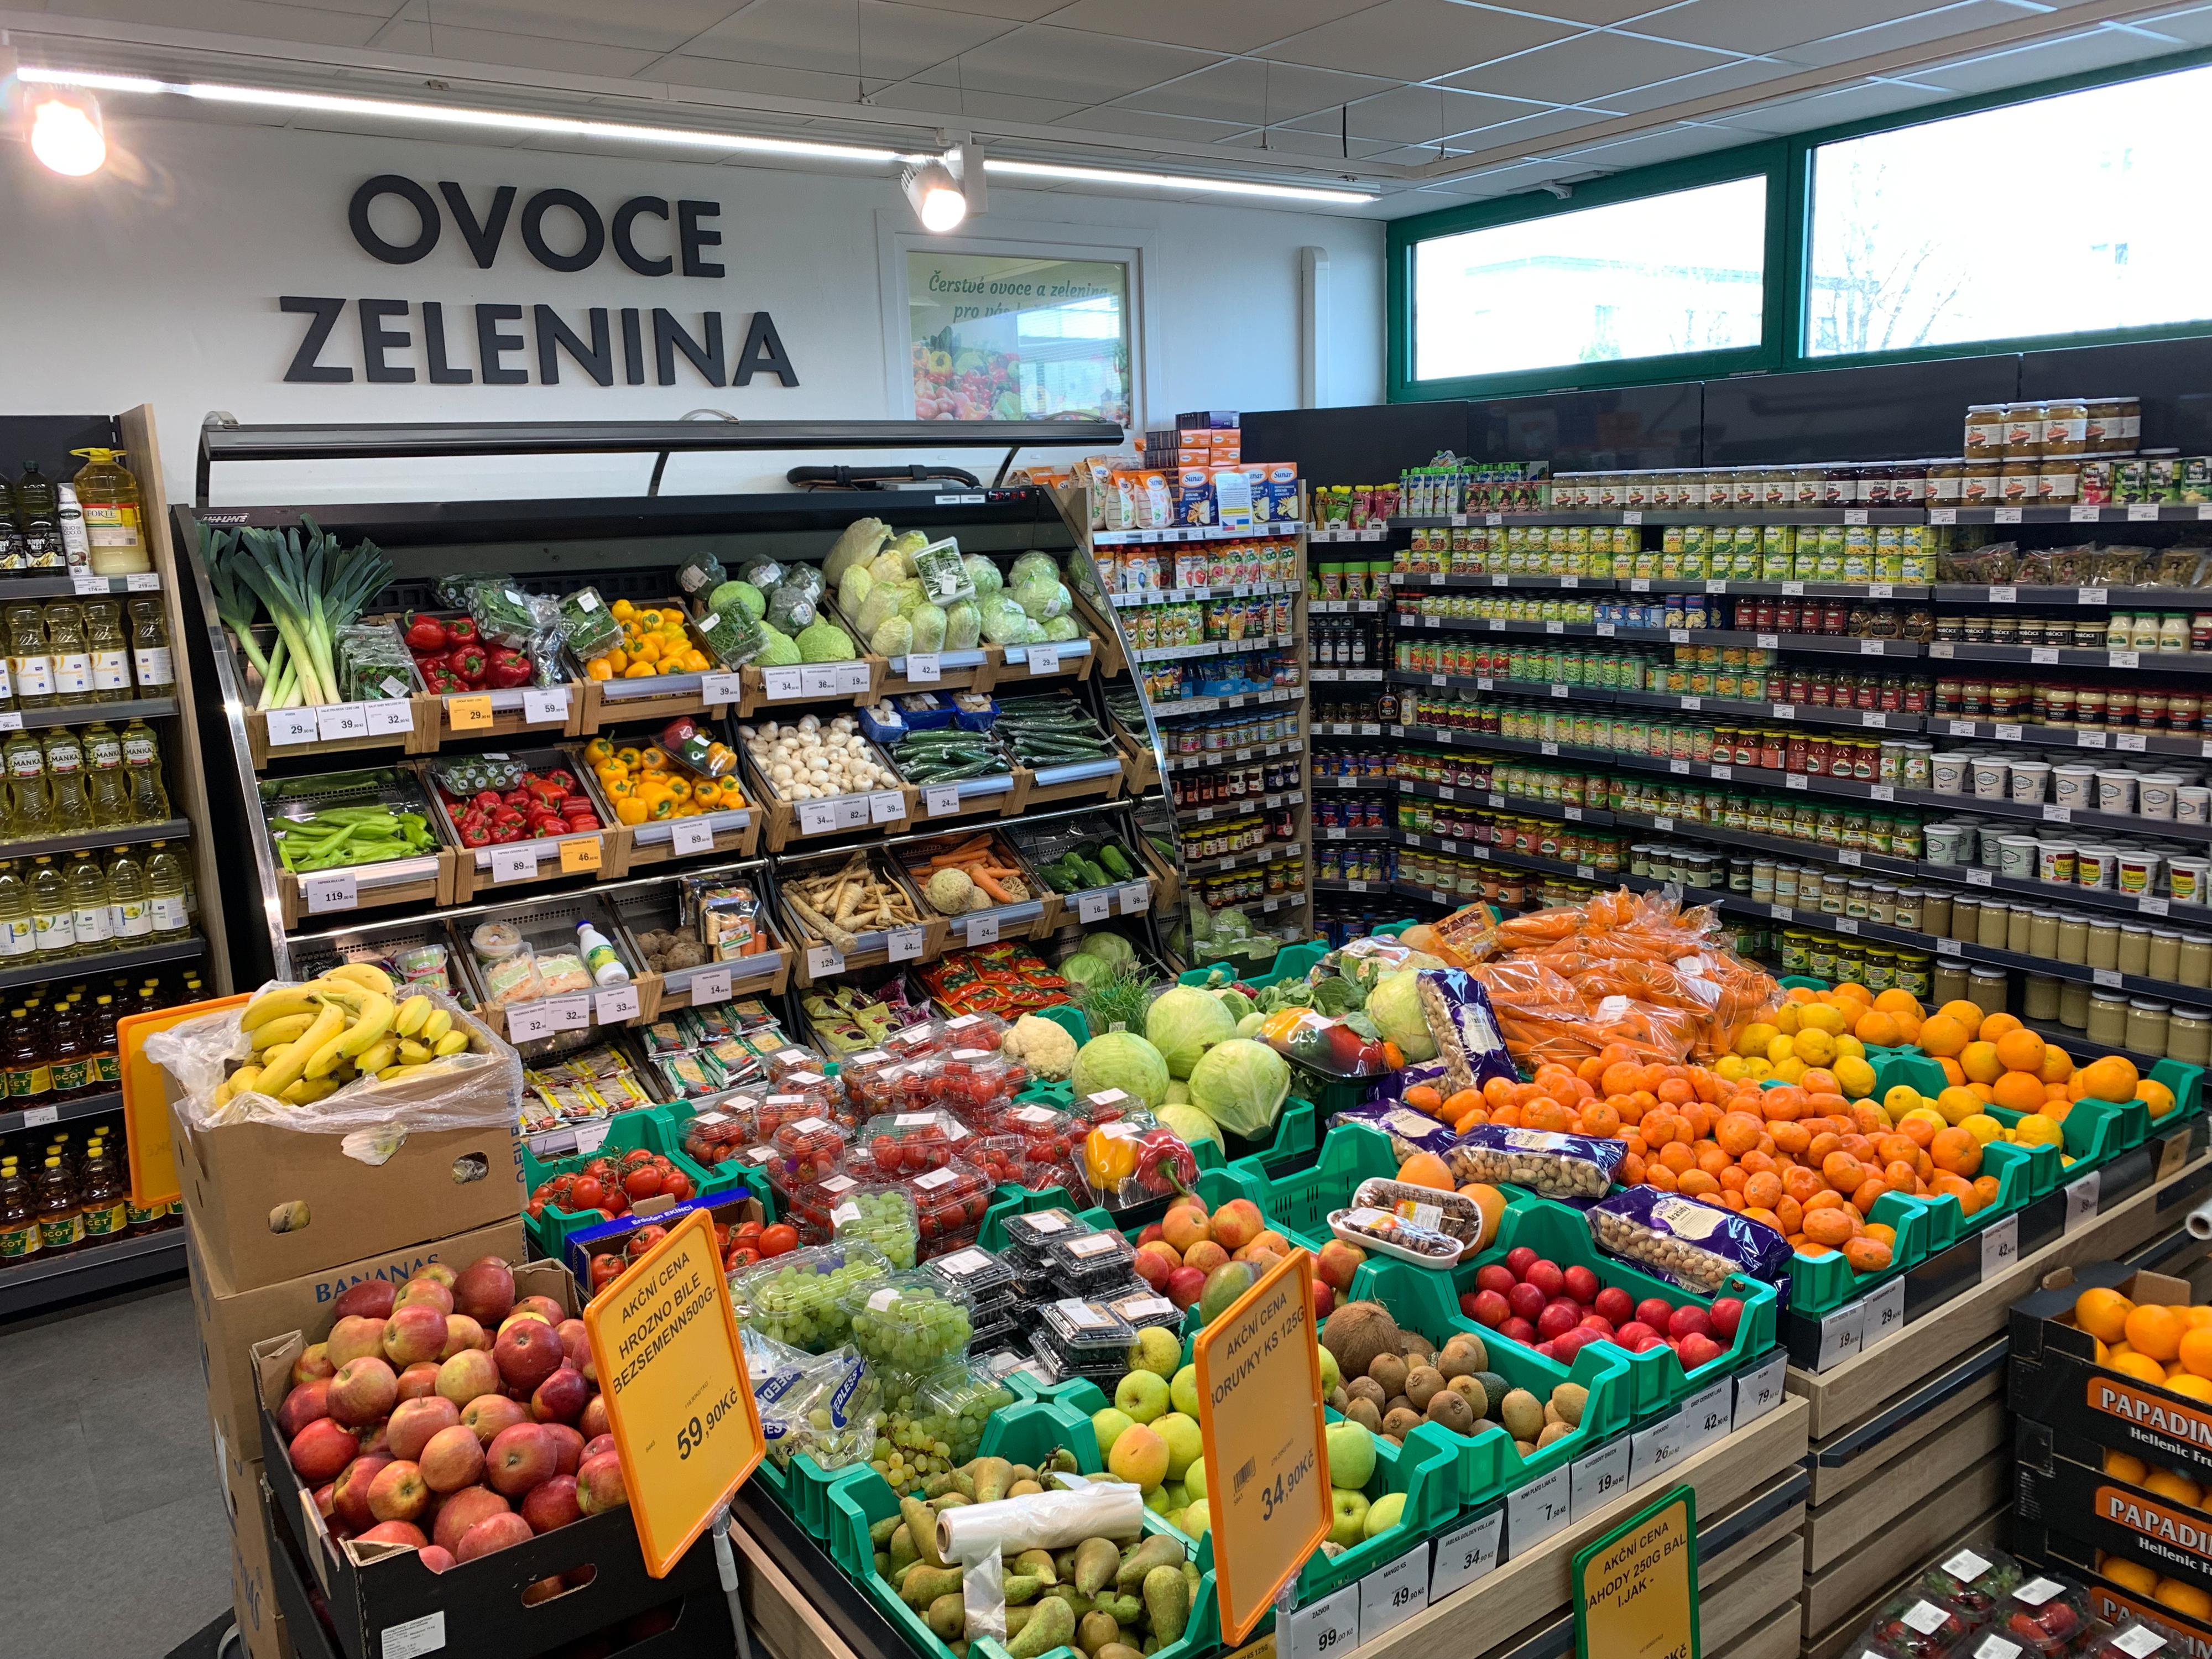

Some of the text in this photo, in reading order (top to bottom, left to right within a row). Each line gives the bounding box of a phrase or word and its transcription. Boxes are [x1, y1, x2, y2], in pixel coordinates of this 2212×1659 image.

[349, 174, 726, 278] OVOCE
[929, 270, 985, 294] Čerstvé
[990, 281, 1031, 296] ovoce
[1036, 284, 1046, 297] a
[953, 305, 979, 324] pro
[279, 296, 800, 387] ZELENINA
[1185, 474, 1203, 483] Sunar
[1274, 471, 1292, 479] Sunar
[86, 509, 116, 519] FORTE
[51, 753, 79, 763] MANKA
[96, 749, 120, 759] MANKA
[125, 747, 153, 755] MANKA
[13, 758, 41, 767] MANKA
[42, 1227, 70, 1237] OCOT
[623, 1251, 691, 1324] AKČNÍ CENA
[618, 1272, 701, 1360] HROZNO BILE
[1227, 1291, 1287, 1361] AKČNÍ CENA
[1264, 1330, 1279, 1357] KS
[1281, 1305, 1305, 1339] 125G
[1652, 1423, 1670, 1437] AVOKADO
[2131, 1426, 2190, 1459] Hellenic
[1584, 1455, 1604, 1470] KOKOSOVY
[1520, 1489, 1530, 1501] KIWI
[1530, 1485, 1542, 1497] PLATO
[1551, 1476, 1557, 1484] KS
[1598, 1474, 1619, 1494] 19,90
[1545, 1503, 1561, 1521] 7,50
[2110, 1496, 2212, 1557] PAPADI
[1445, 1533, 1461, 1548] JABLKA
[1460, 1527, 1477, 1542] GOLDEN
[1603, 1521, 1669, 1575] AKČNÍ CENA
[1463, 1548, 1488, 1571] 34,90
[1633, 1550, 1661, 1578] 250G
[1664, 1533, 1687, 1557] BAL
[2139, 1536, 2198, 1570] Hellenic
[1383, 1562, 1407, 1579] MANGO KS
[1392, 1587, 1418, 1608] 49,90
[1311, 1604, 1331, 1620] ZAZVOR
[1318, 1628, 1346, 1652] 99,00
